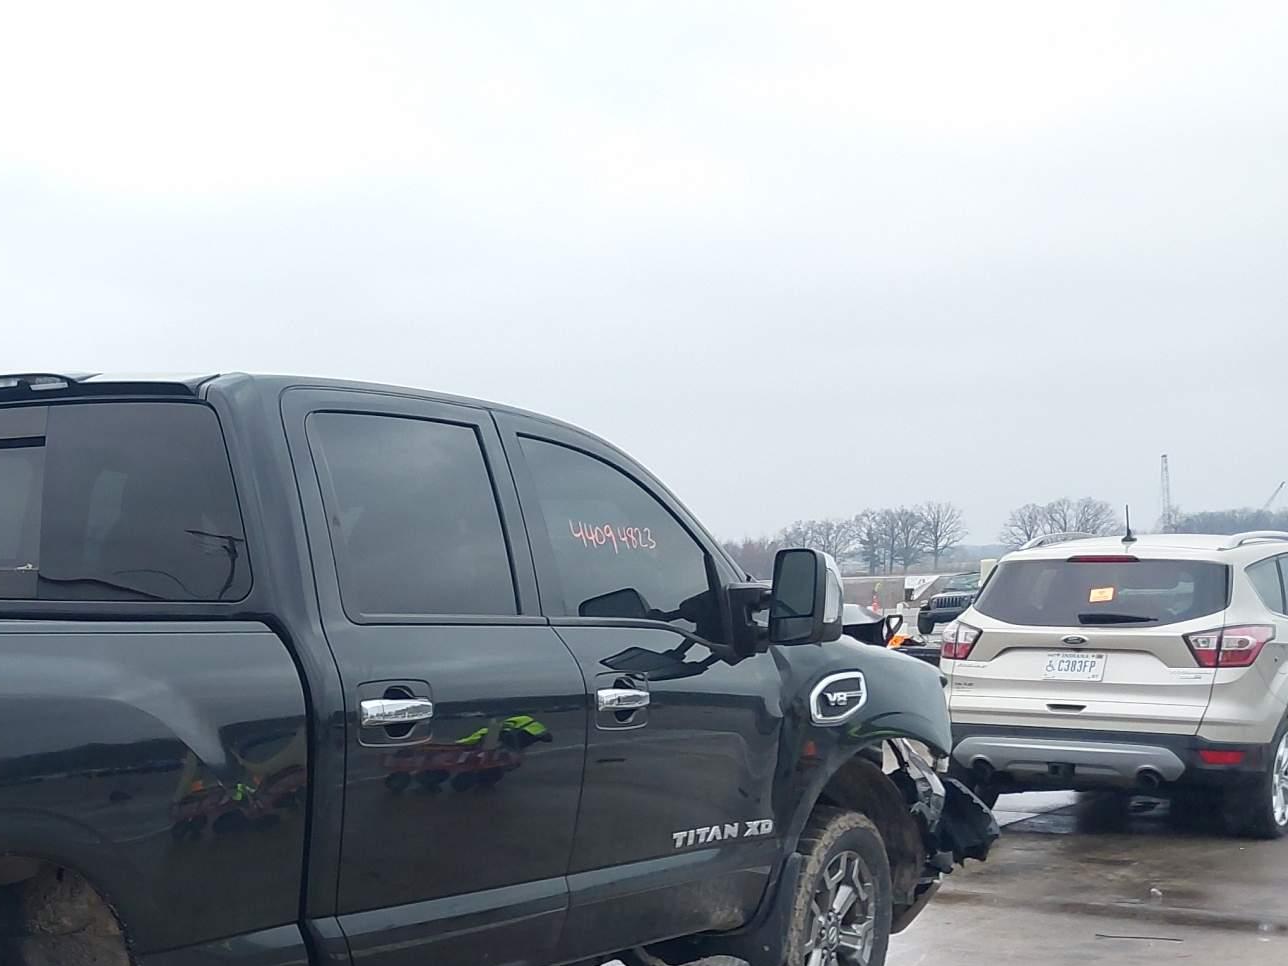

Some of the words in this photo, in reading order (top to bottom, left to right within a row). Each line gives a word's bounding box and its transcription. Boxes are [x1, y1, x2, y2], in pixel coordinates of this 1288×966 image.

[823, 691, 848, 706] V8
[672, 823, 740, 848] TITAN
[744, 819, 773, 837] XD
